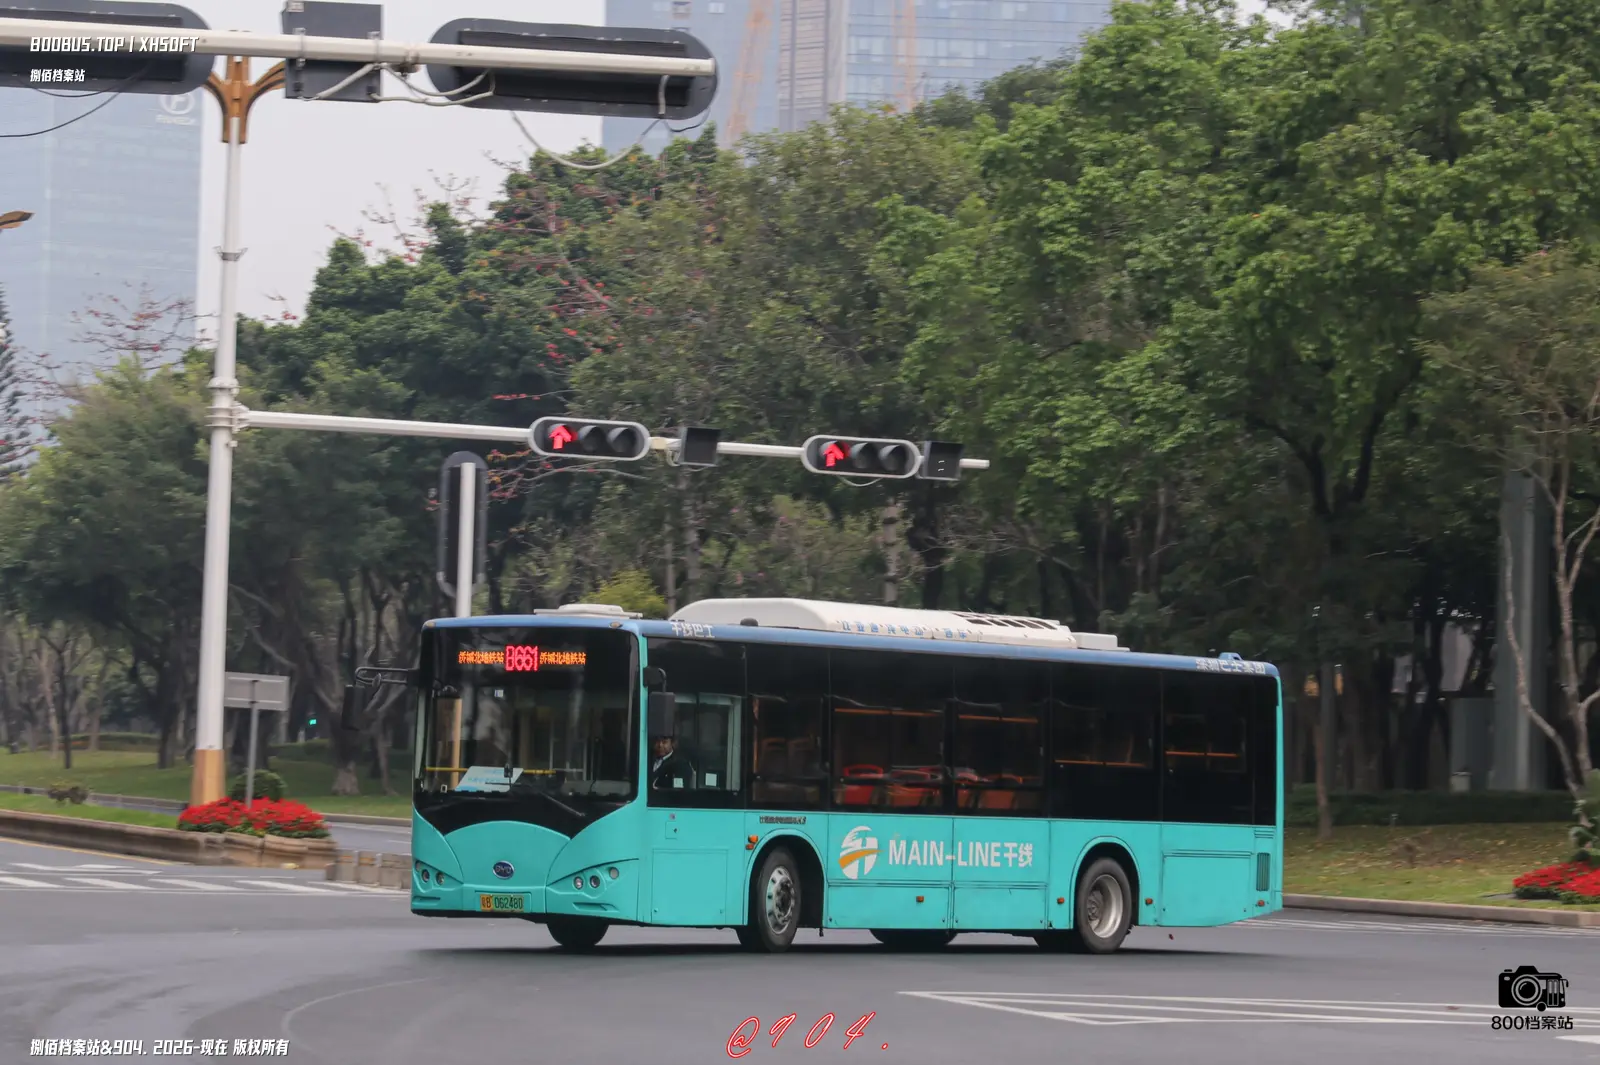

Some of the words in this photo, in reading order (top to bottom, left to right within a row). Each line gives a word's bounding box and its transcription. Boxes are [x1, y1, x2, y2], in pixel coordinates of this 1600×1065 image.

[670, 621, 715, 638] 干线巴士
[505, 645, 538, 671] B661
[495, 865, 512, 874] BYD
